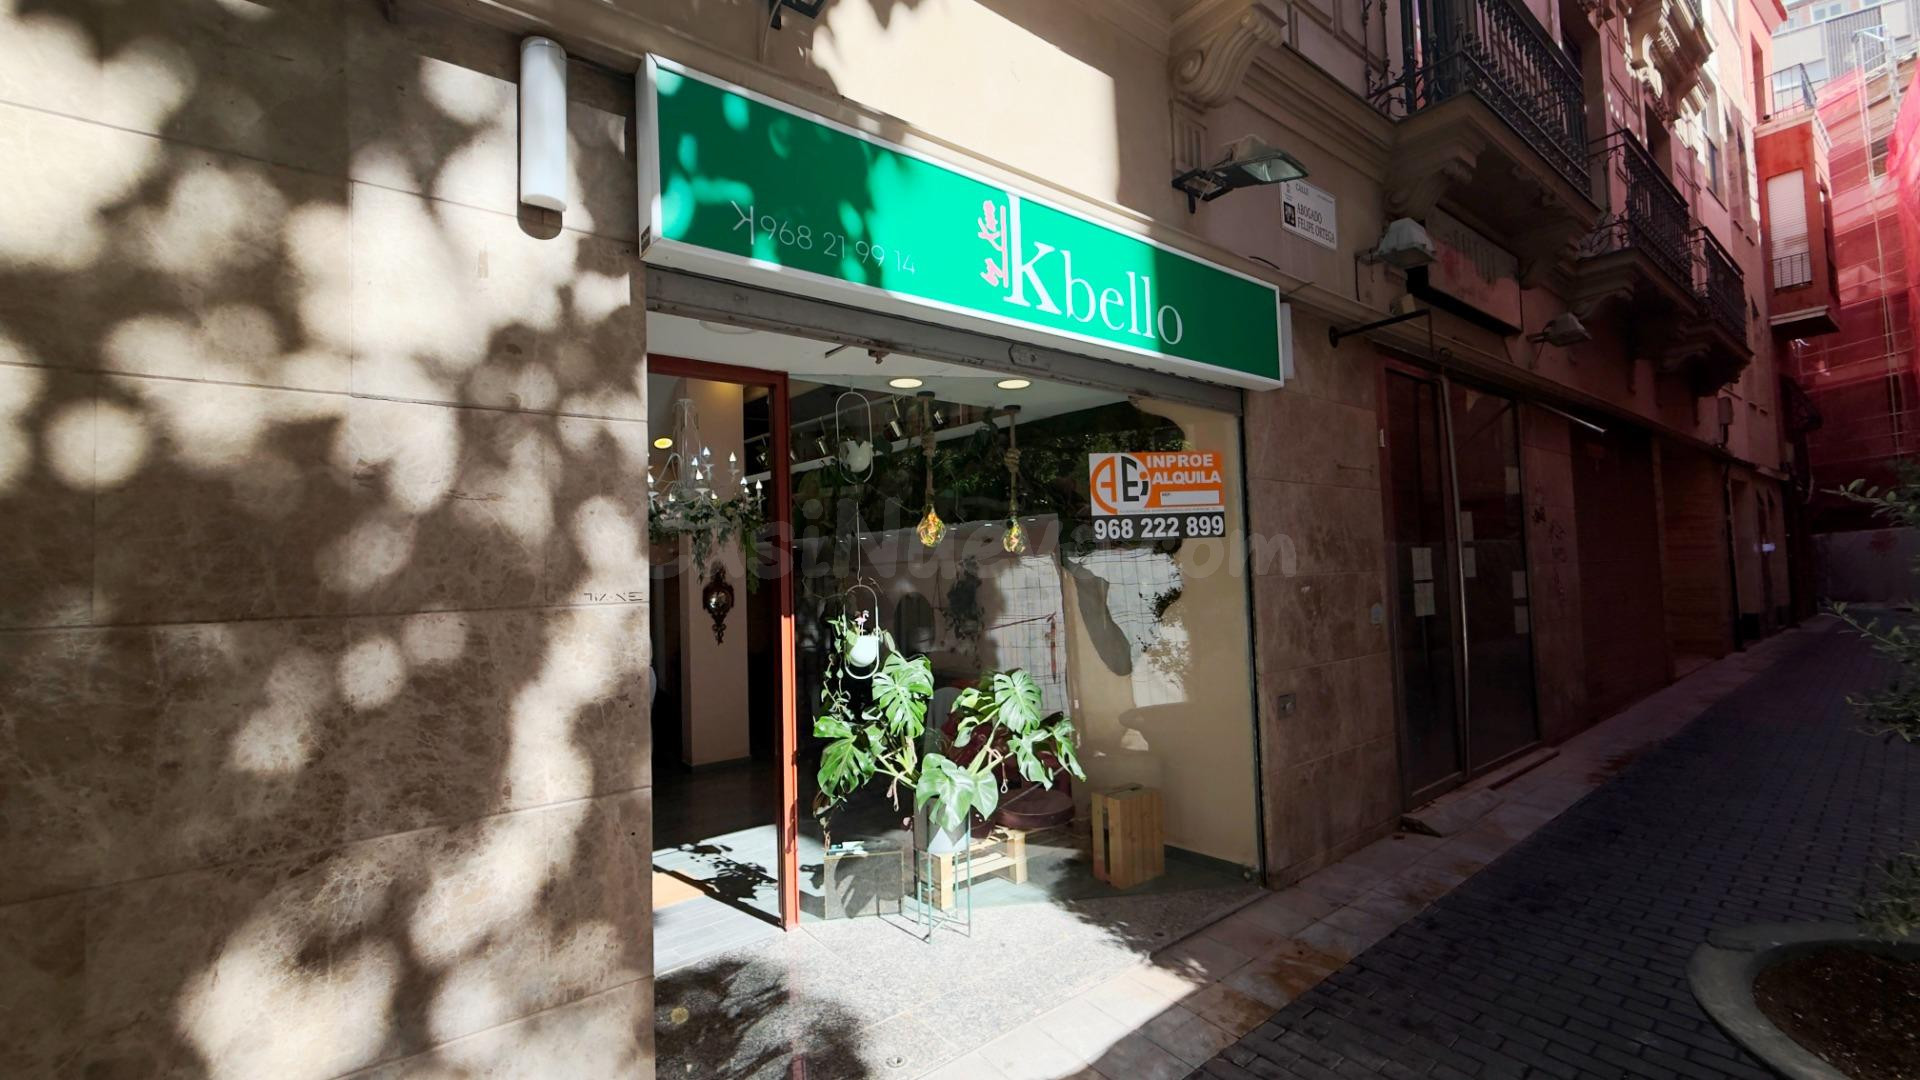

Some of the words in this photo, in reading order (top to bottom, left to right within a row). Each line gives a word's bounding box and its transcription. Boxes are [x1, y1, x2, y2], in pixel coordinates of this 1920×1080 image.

[1297, 216, 1315, 234] FELIPE
[760, 215, 813, 250] 968
[823, 231, 846, 259] 21
[855, 240, 885, 267] 99
[894, 249, 916, 275] 14
[1146, 453, 1213, 469] INPROE
[1151, 470, 1222, 485] ALQUILA
[1094, 518, 1133, 540] 968
[1140, 517, 1180, 538] 222
[1186, 515, 1225, 537] 899
